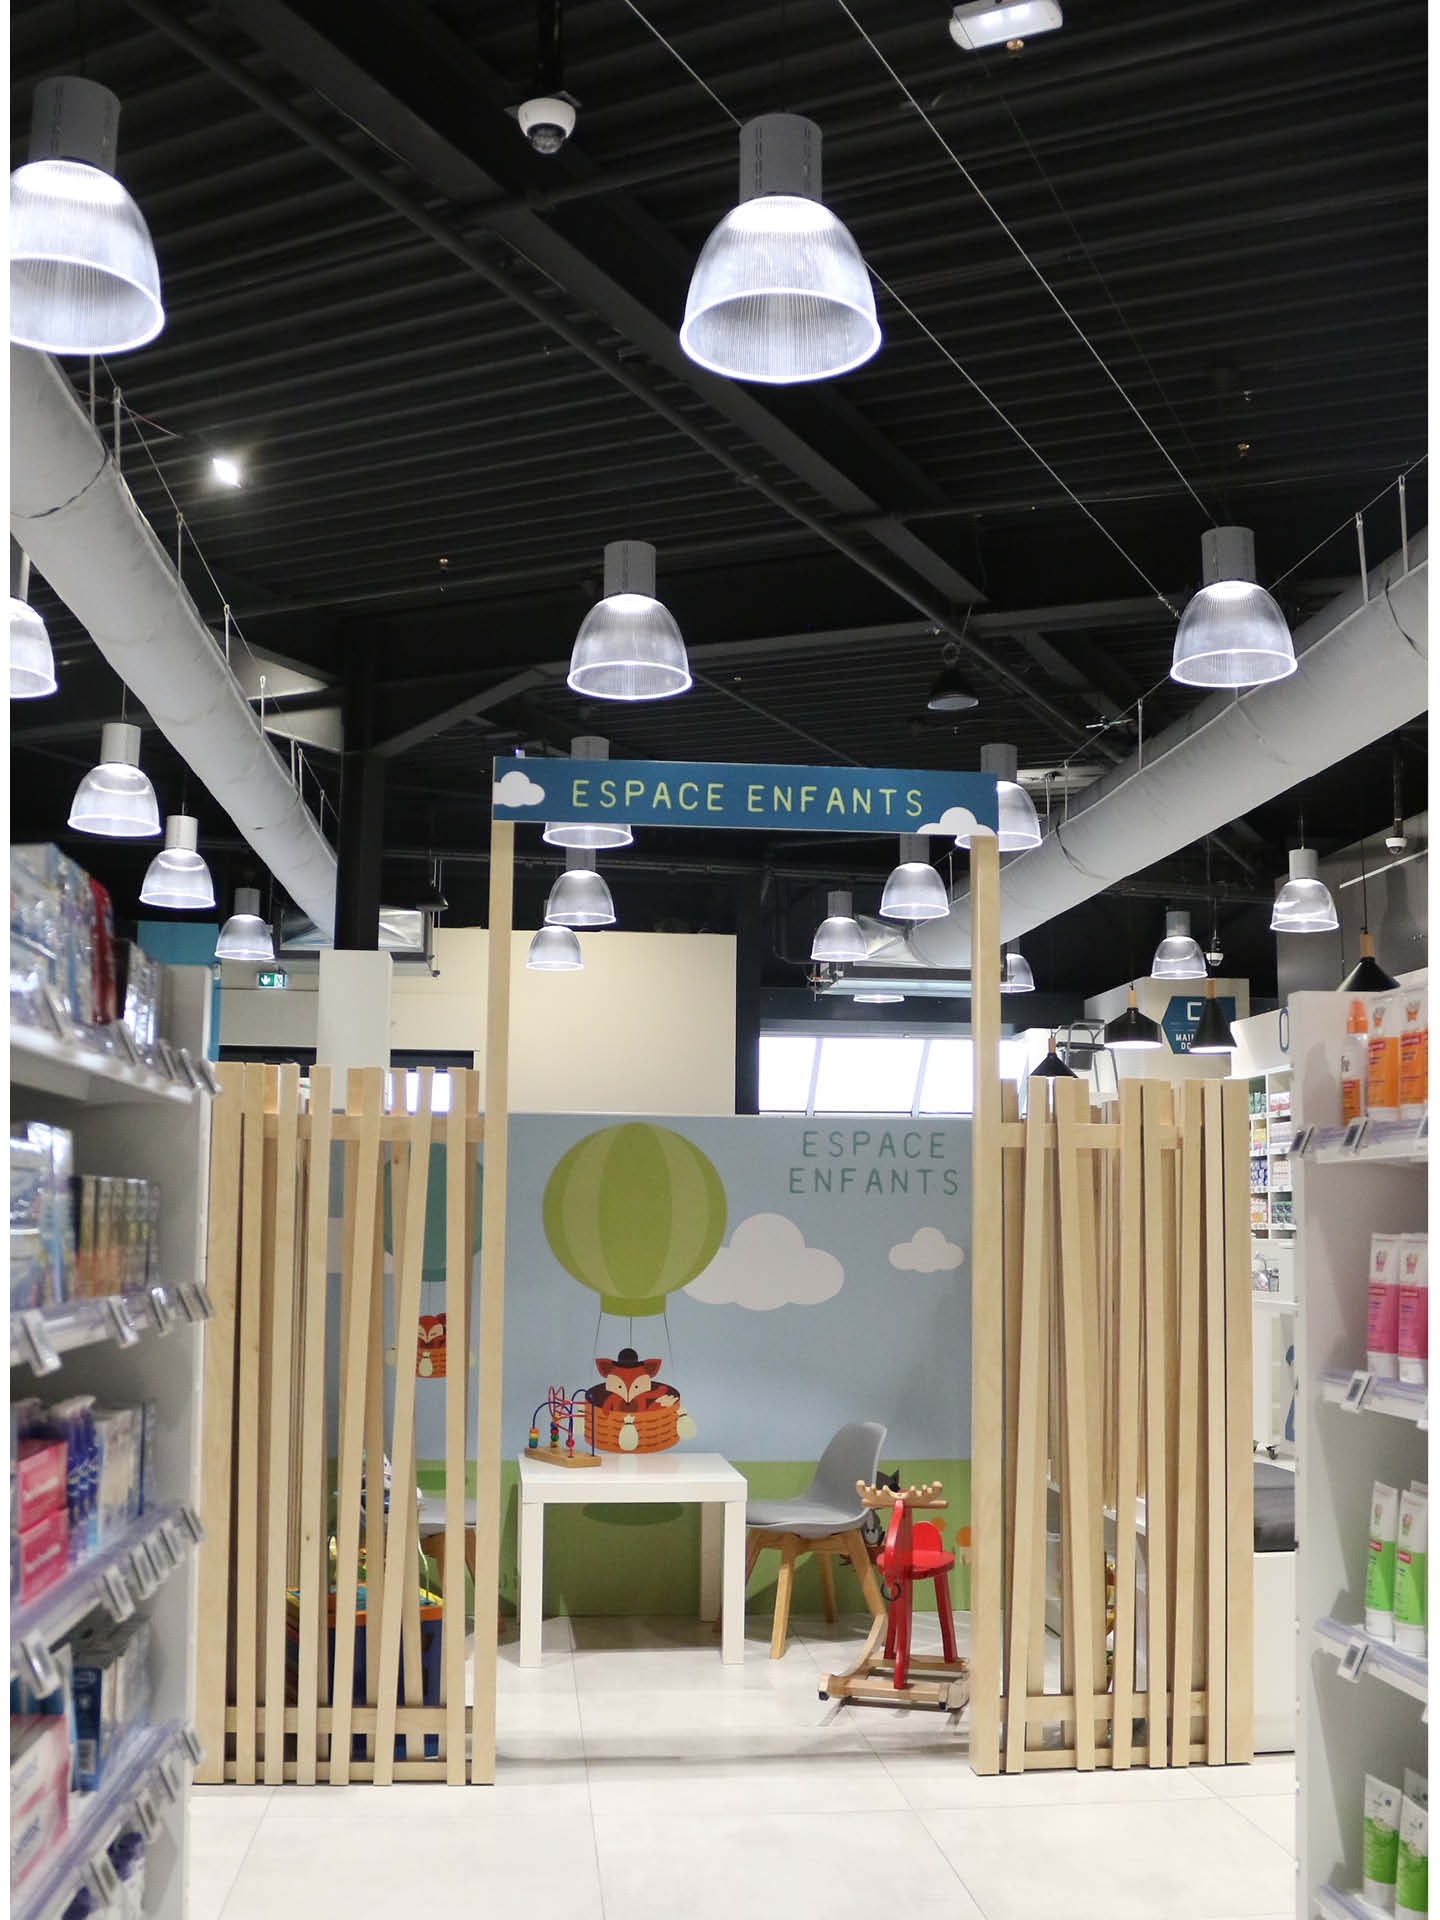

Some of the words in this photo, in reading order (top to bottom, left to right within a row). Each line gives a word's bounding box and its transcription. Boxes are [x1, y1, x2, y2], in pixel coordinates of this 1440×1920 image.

[572, 779, 724, 811] ESPACE
[747, 785, 923, 817] ENFANTS
[802, 1131, 945, 1159] ESPACE
[789, 1167, 958, 1196] ENFANTS
